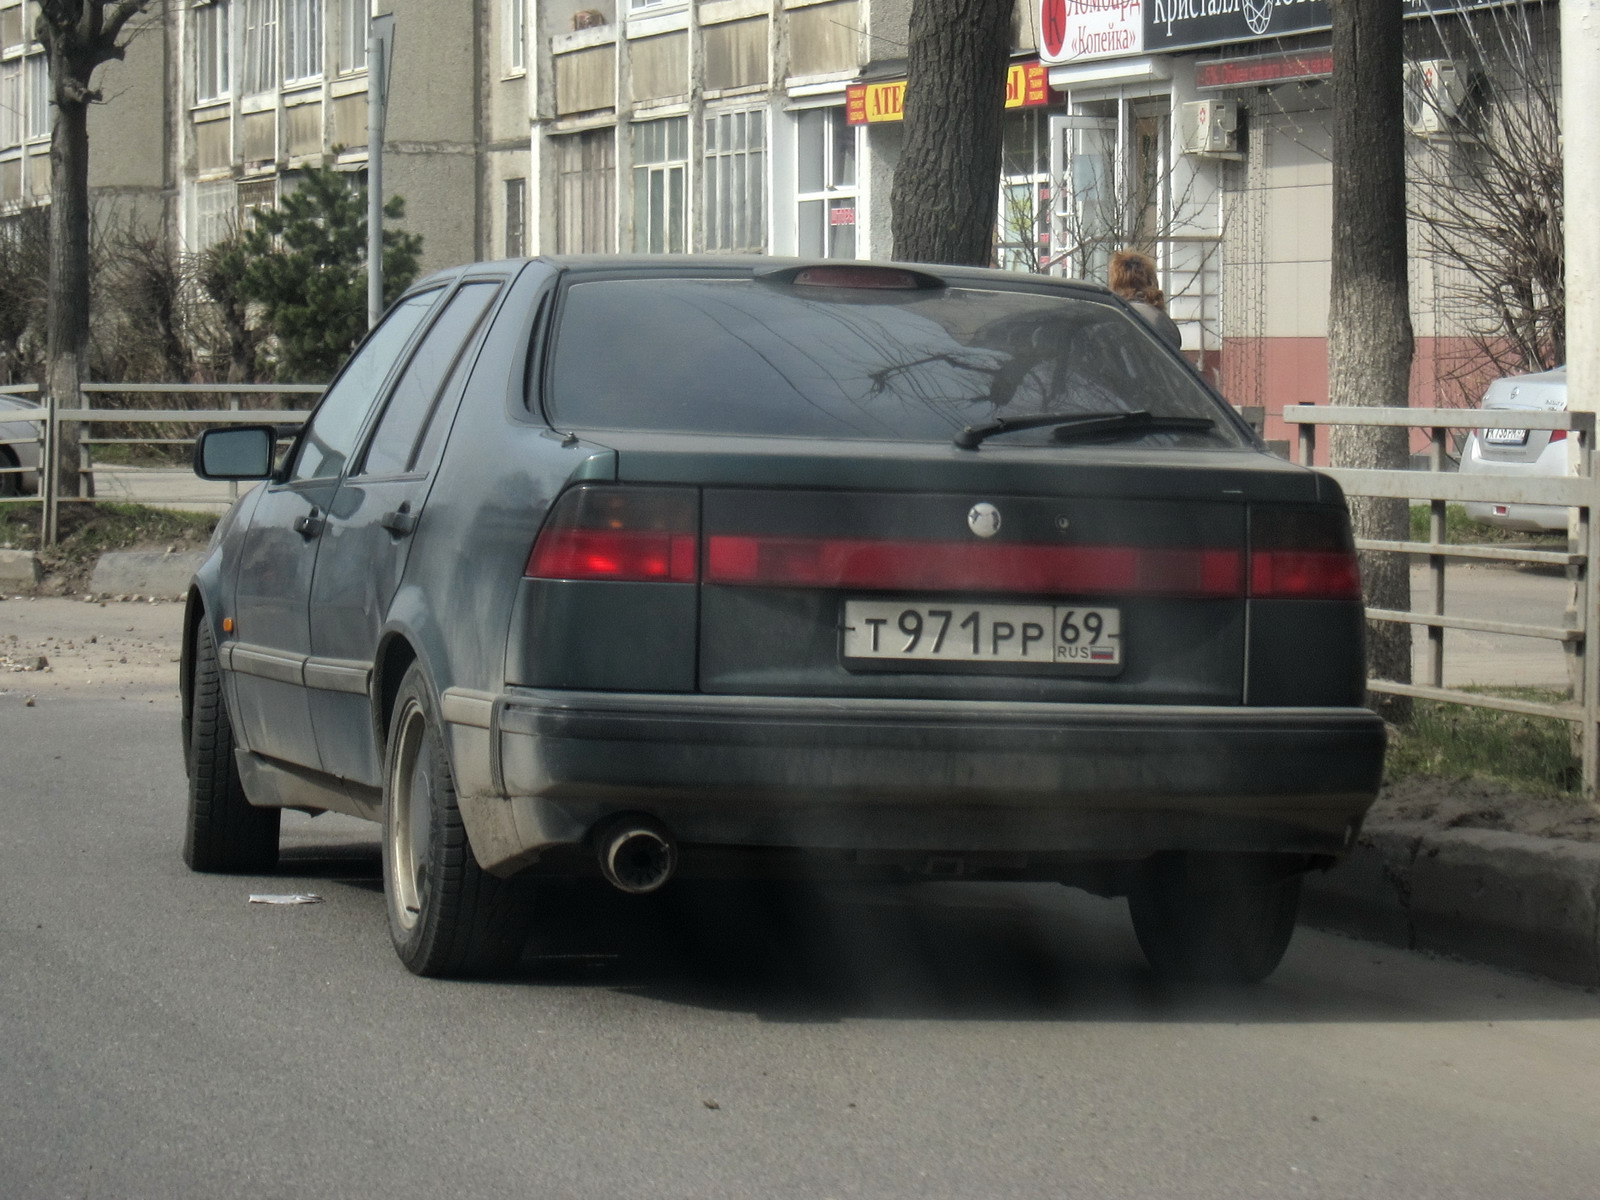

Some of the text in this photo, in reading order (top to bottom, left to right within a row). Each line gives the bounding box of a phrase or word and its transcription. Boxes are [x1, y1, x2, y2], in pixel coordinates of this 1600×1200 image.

[1071, 22, 1136, 54] «Копейка»
[872, 86, 902, 116] АТЕ
[1060, 611, 1103, 645] 69
[1057, 646, 1089, 658] RUS
